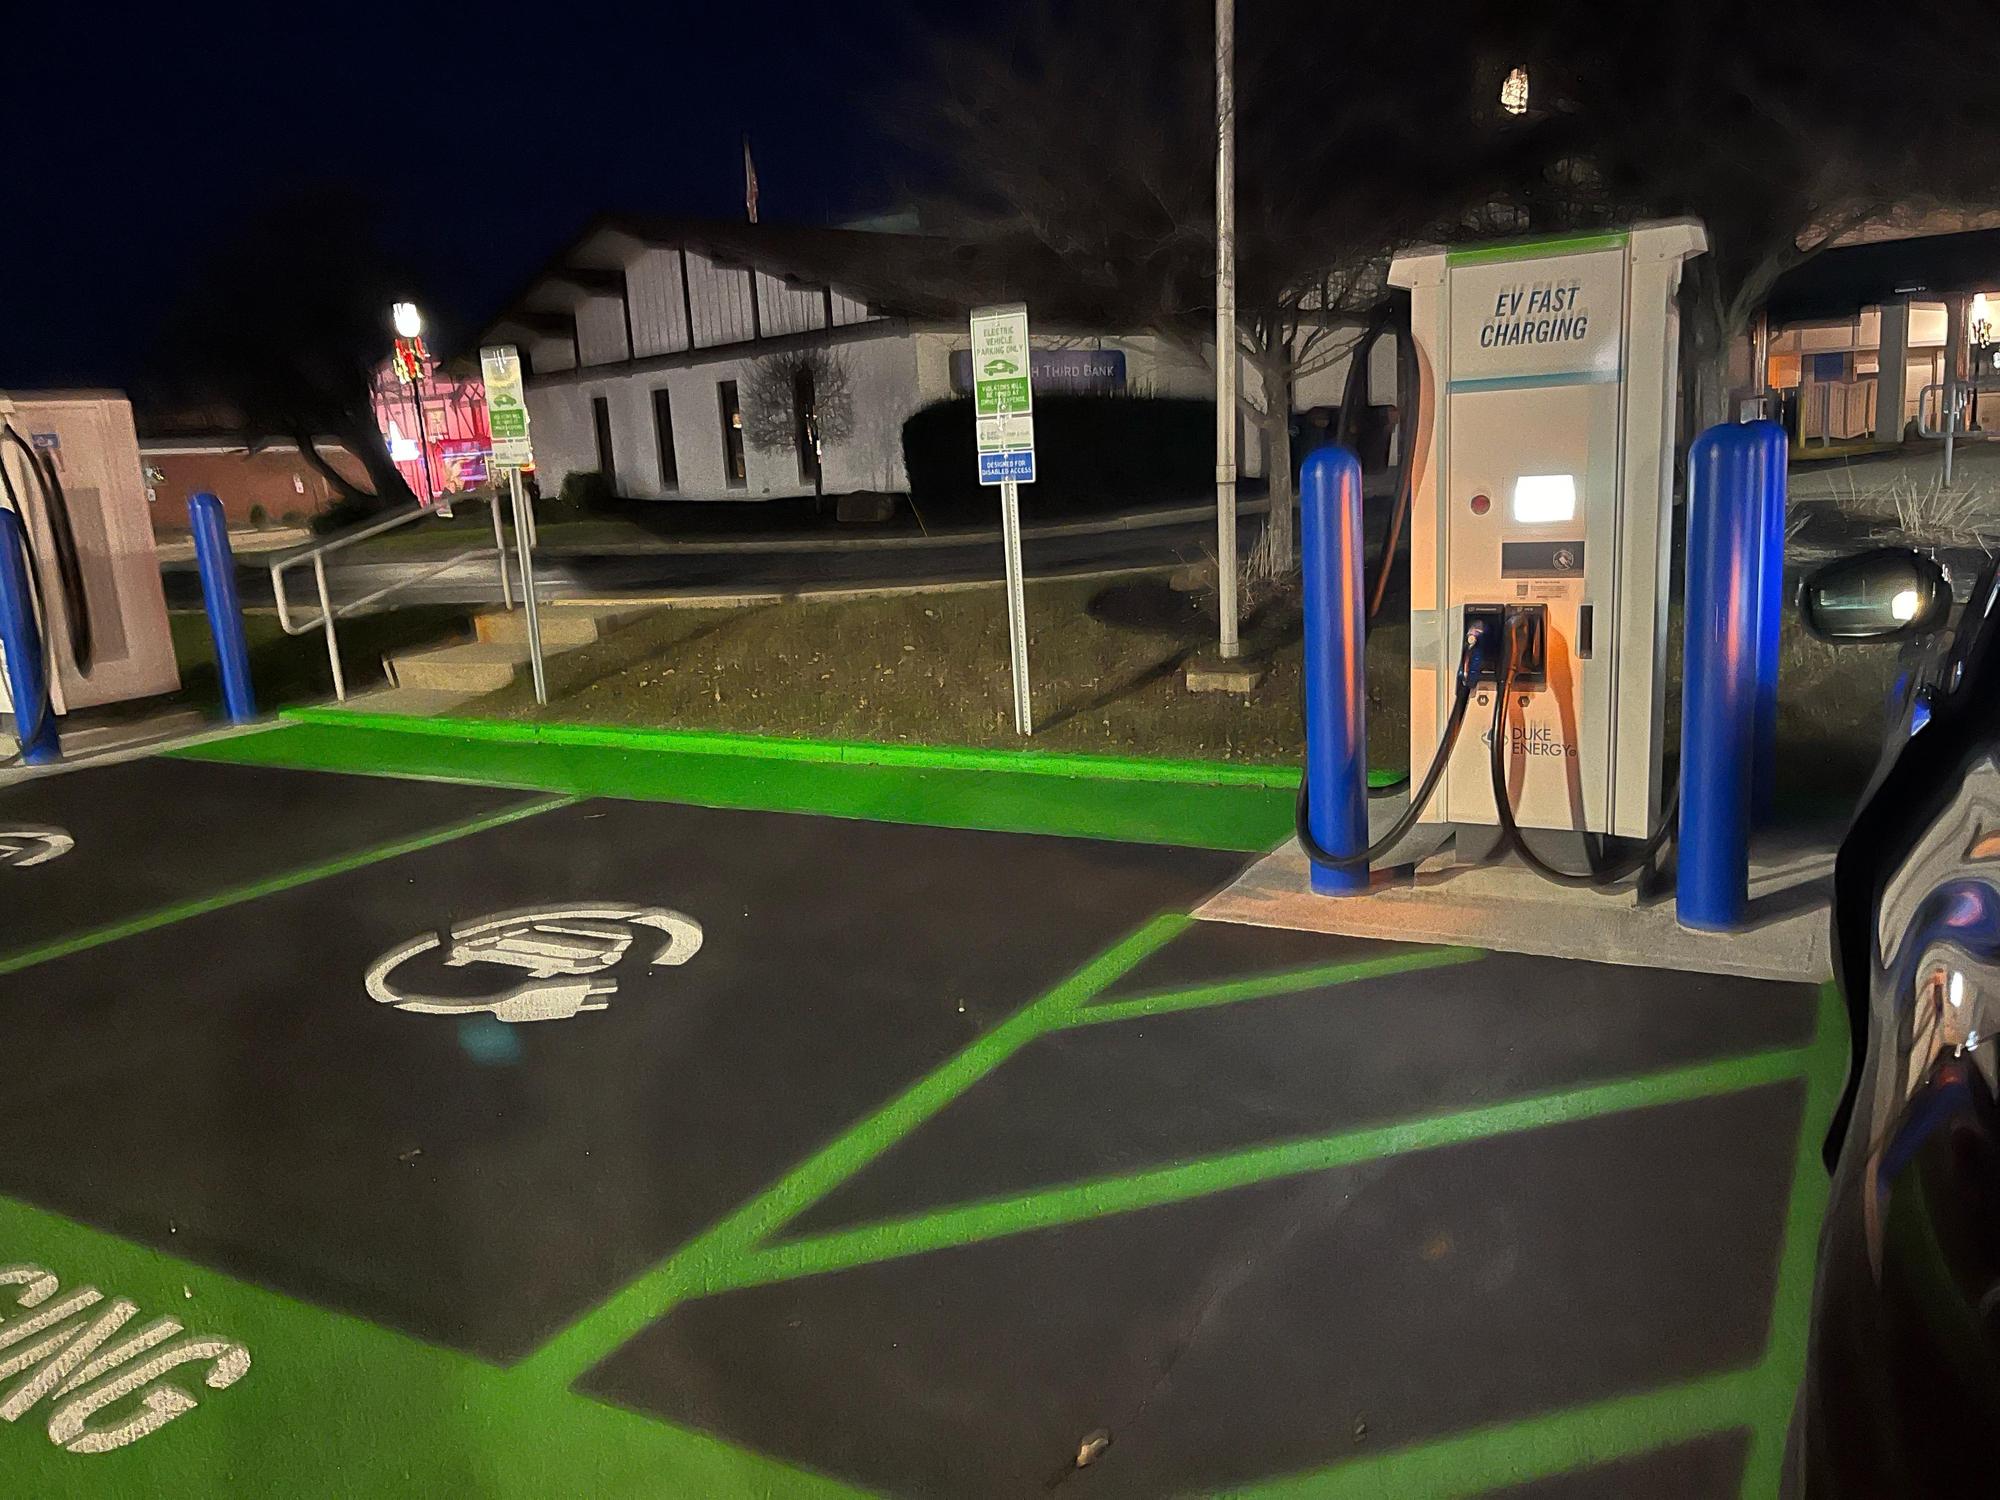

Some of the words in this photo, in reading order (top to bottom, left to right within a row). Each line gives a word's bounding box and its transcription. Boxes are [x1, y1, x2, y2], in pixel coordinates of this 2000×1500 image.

[1495, 292, 1524, 317] EV
[1527, 286, 1580, 314] FAST
[983, 326, 1014, 338] ELECTRIC
[1480, 316, 1588, 348] CHARGING
[986, 335, 1013, 346] VEHICLE
[976, 346, 1005, 357] PARKING
[1006, 343, 1024, 353] ONLY
[1043, 364, 1080, 377] THIRD
[1083, 364, 1114, 376] BANK
[986, 460, 1014, 468] DESIGNED
[981, 468, 1009, 476] DISABLED
[1010, 466, 1032, 474] ACCESS
[1512, 727, 1552, 742] DUKE
[1512, 742, 1571, 757] ENERGY
